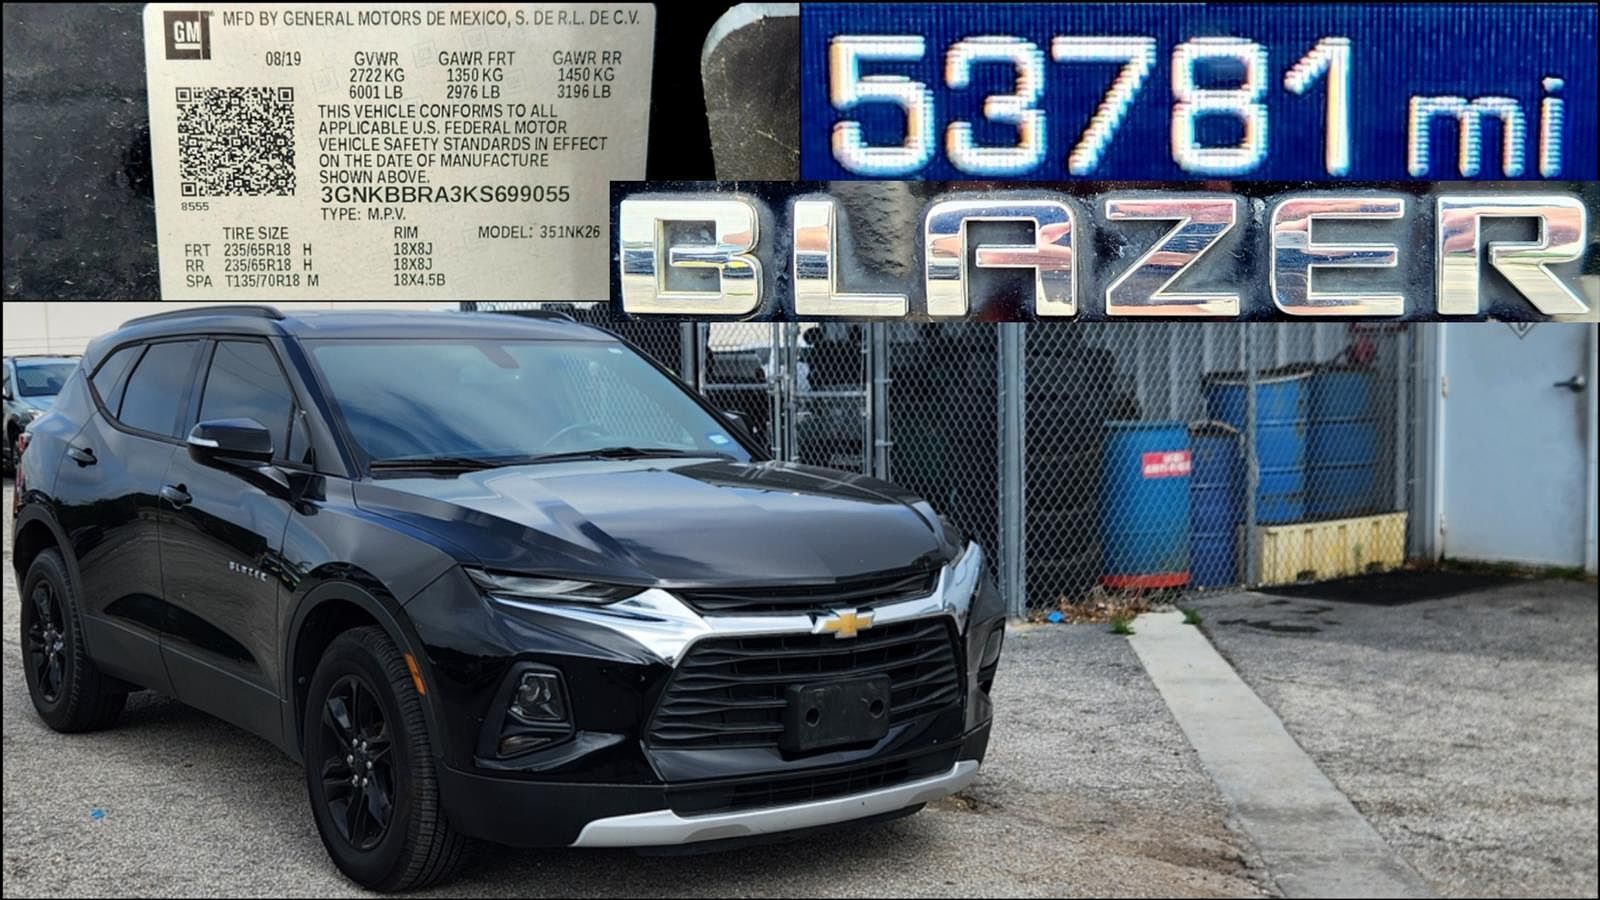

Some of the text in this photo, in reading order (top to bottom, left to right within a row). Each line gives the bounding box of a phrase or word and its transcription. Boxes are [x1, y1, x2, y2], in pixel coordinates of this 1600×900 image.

[223, 10, 639, 28] MFD BY GENERAL MOTORS DE MEXICO, S. DE R.L. DE C.V.
[174, 20, 201, 43] GM
[266, 51, 301, 67] 08/19
[353, 51, 399, 66] GVWR
[438, 51, 516, 65] GAWR FRT
[553, 51, 622, 66] GAWR RR
[350, 67, 405, 83] 2722 KG
[447, 67, 503, 82] 1350 KG
[558, 67, 615, 82] 1450 KG
[349, 84, 403, 99] 6001 LB
[447, 84, 500, 99] 2976 LB
[557, 84, 611, 99] 3196 LB
[318, 104, 560, 118] THIS VEHICLE CONFORMS TO ALL
[829, 35, 1563, 178] 53781 mi
[319, 120, 567, 135] APPLICABLE U.S. FEDERAL MOTOR
[318, 136, 608, 152] VEHICLE SAFETY STANDARDS IN EFFECT
[319, 152, 549, 168] ON THE DATE OF MANUFACTURE
[319, 169, 430, 184] SHOWN ABOVE.
[321, 185, 570, 204] 3GNKBBRA3KS699055
[181, 200, 209, 211] 8555
[321, 207, 406, 221] TYPE: M.P.V.
[222, 226, 289, 240] TIRE SIZE
[394, 226, 418, 239] RIM
[478, 225, 600, 239] MODEL: 351NK26
[185, 243, 312, 258] FRT 235/65R18 H
[394, 242, 432, 256] 18X8J
[620, 195, 1592, 317] BLAZER
[186, 258, 312, 273] RR 235/65R18 H
[394, 257, 433, 271] 18X8J
[186, 273, 319, 288] SPA T135/70R18 M
[394, 273, 446, 286] 18X4.5B
